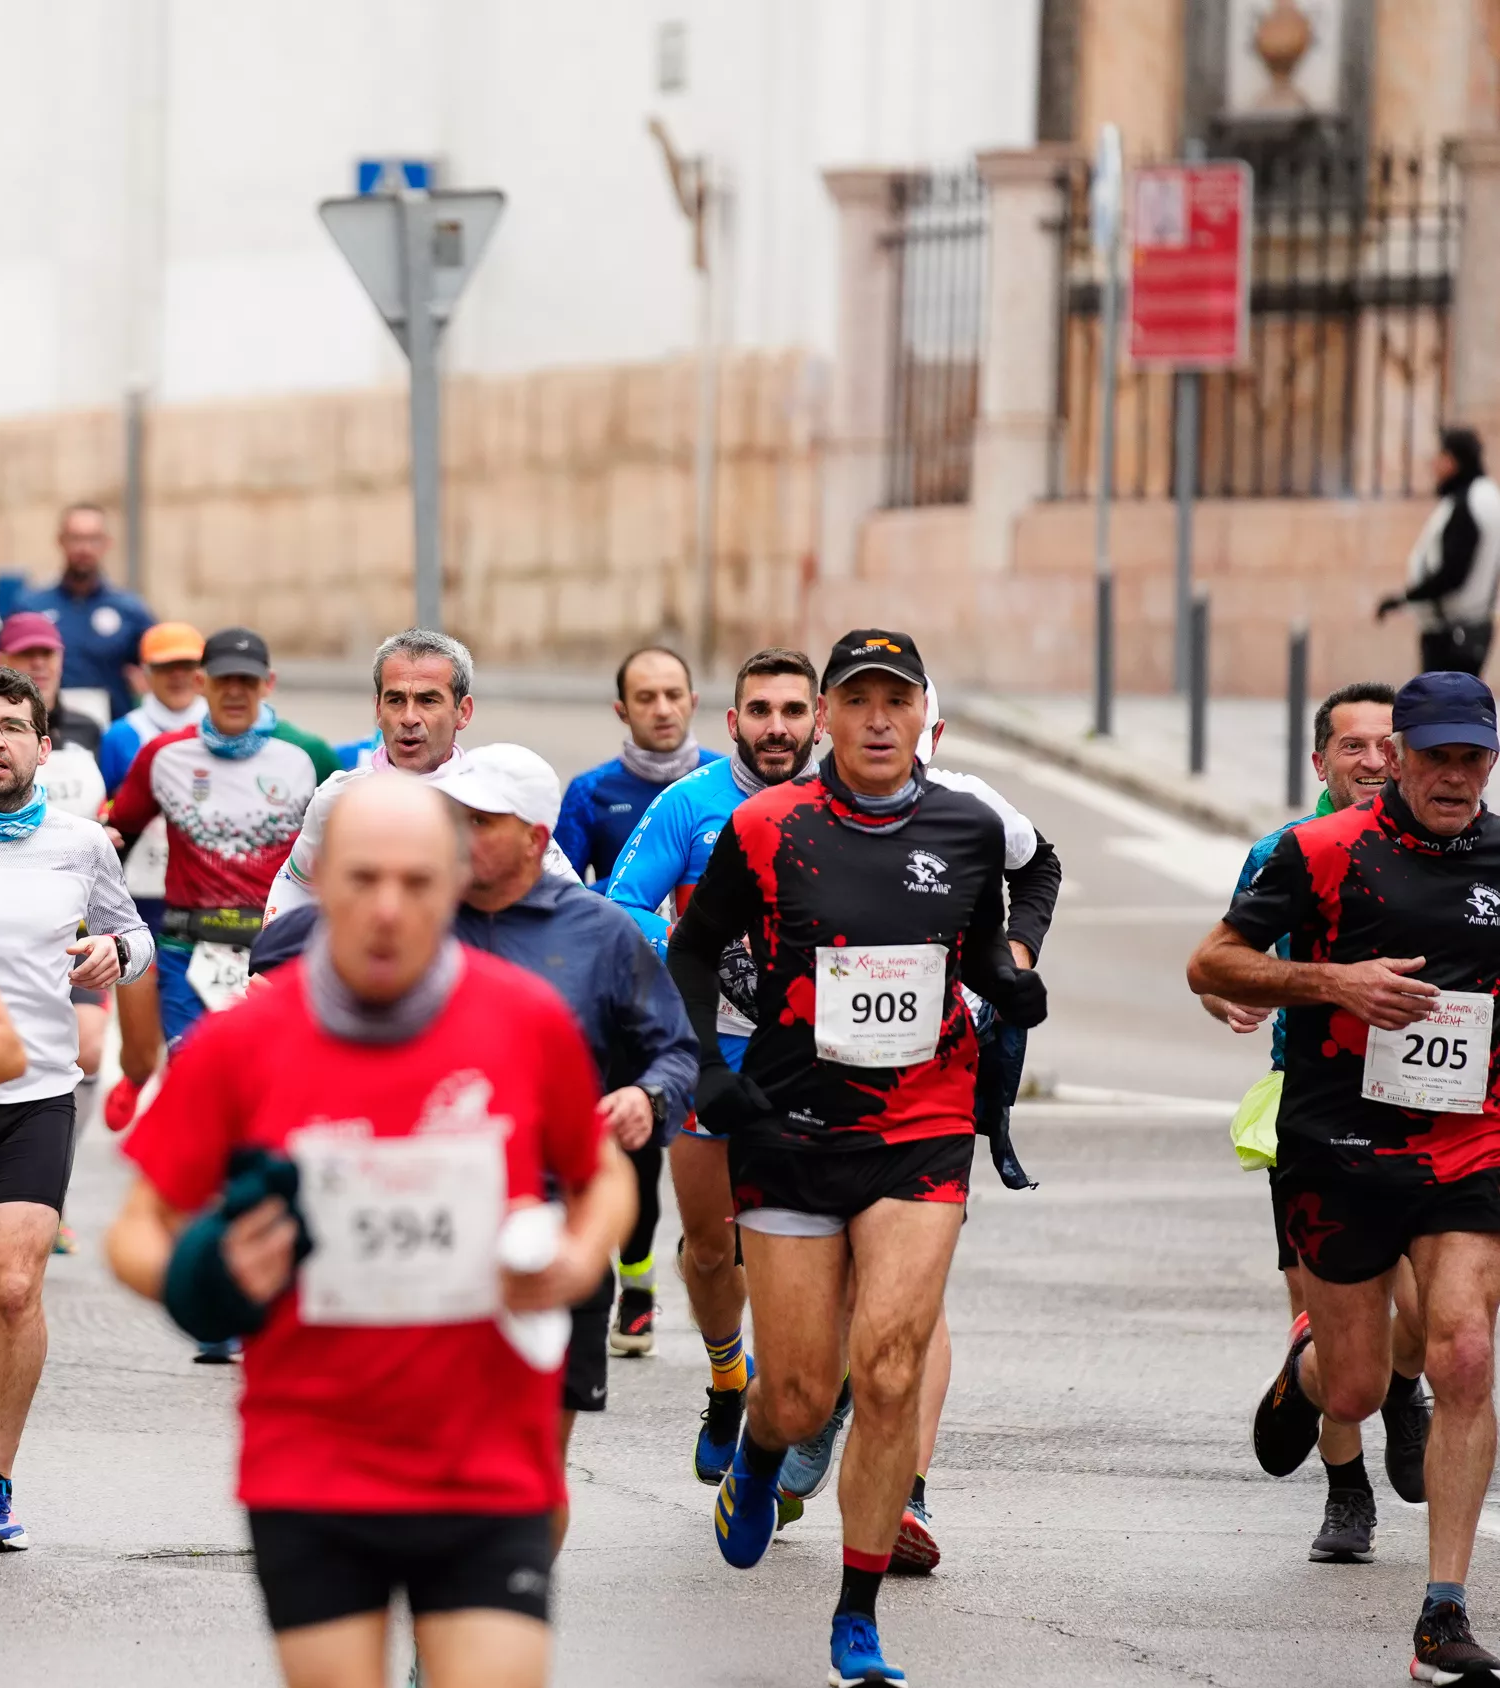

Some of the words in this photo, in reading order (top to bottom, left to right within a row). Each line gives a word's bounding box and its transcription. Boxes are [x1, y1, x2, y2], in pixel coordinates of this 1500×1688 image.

[852, 991, 918, 1024] 908
[1426, 1010, 1465, 1027] LUCENA
[1402, 1034, 1468, 1070] 205
[352, 1205, 455, 1258] 594
